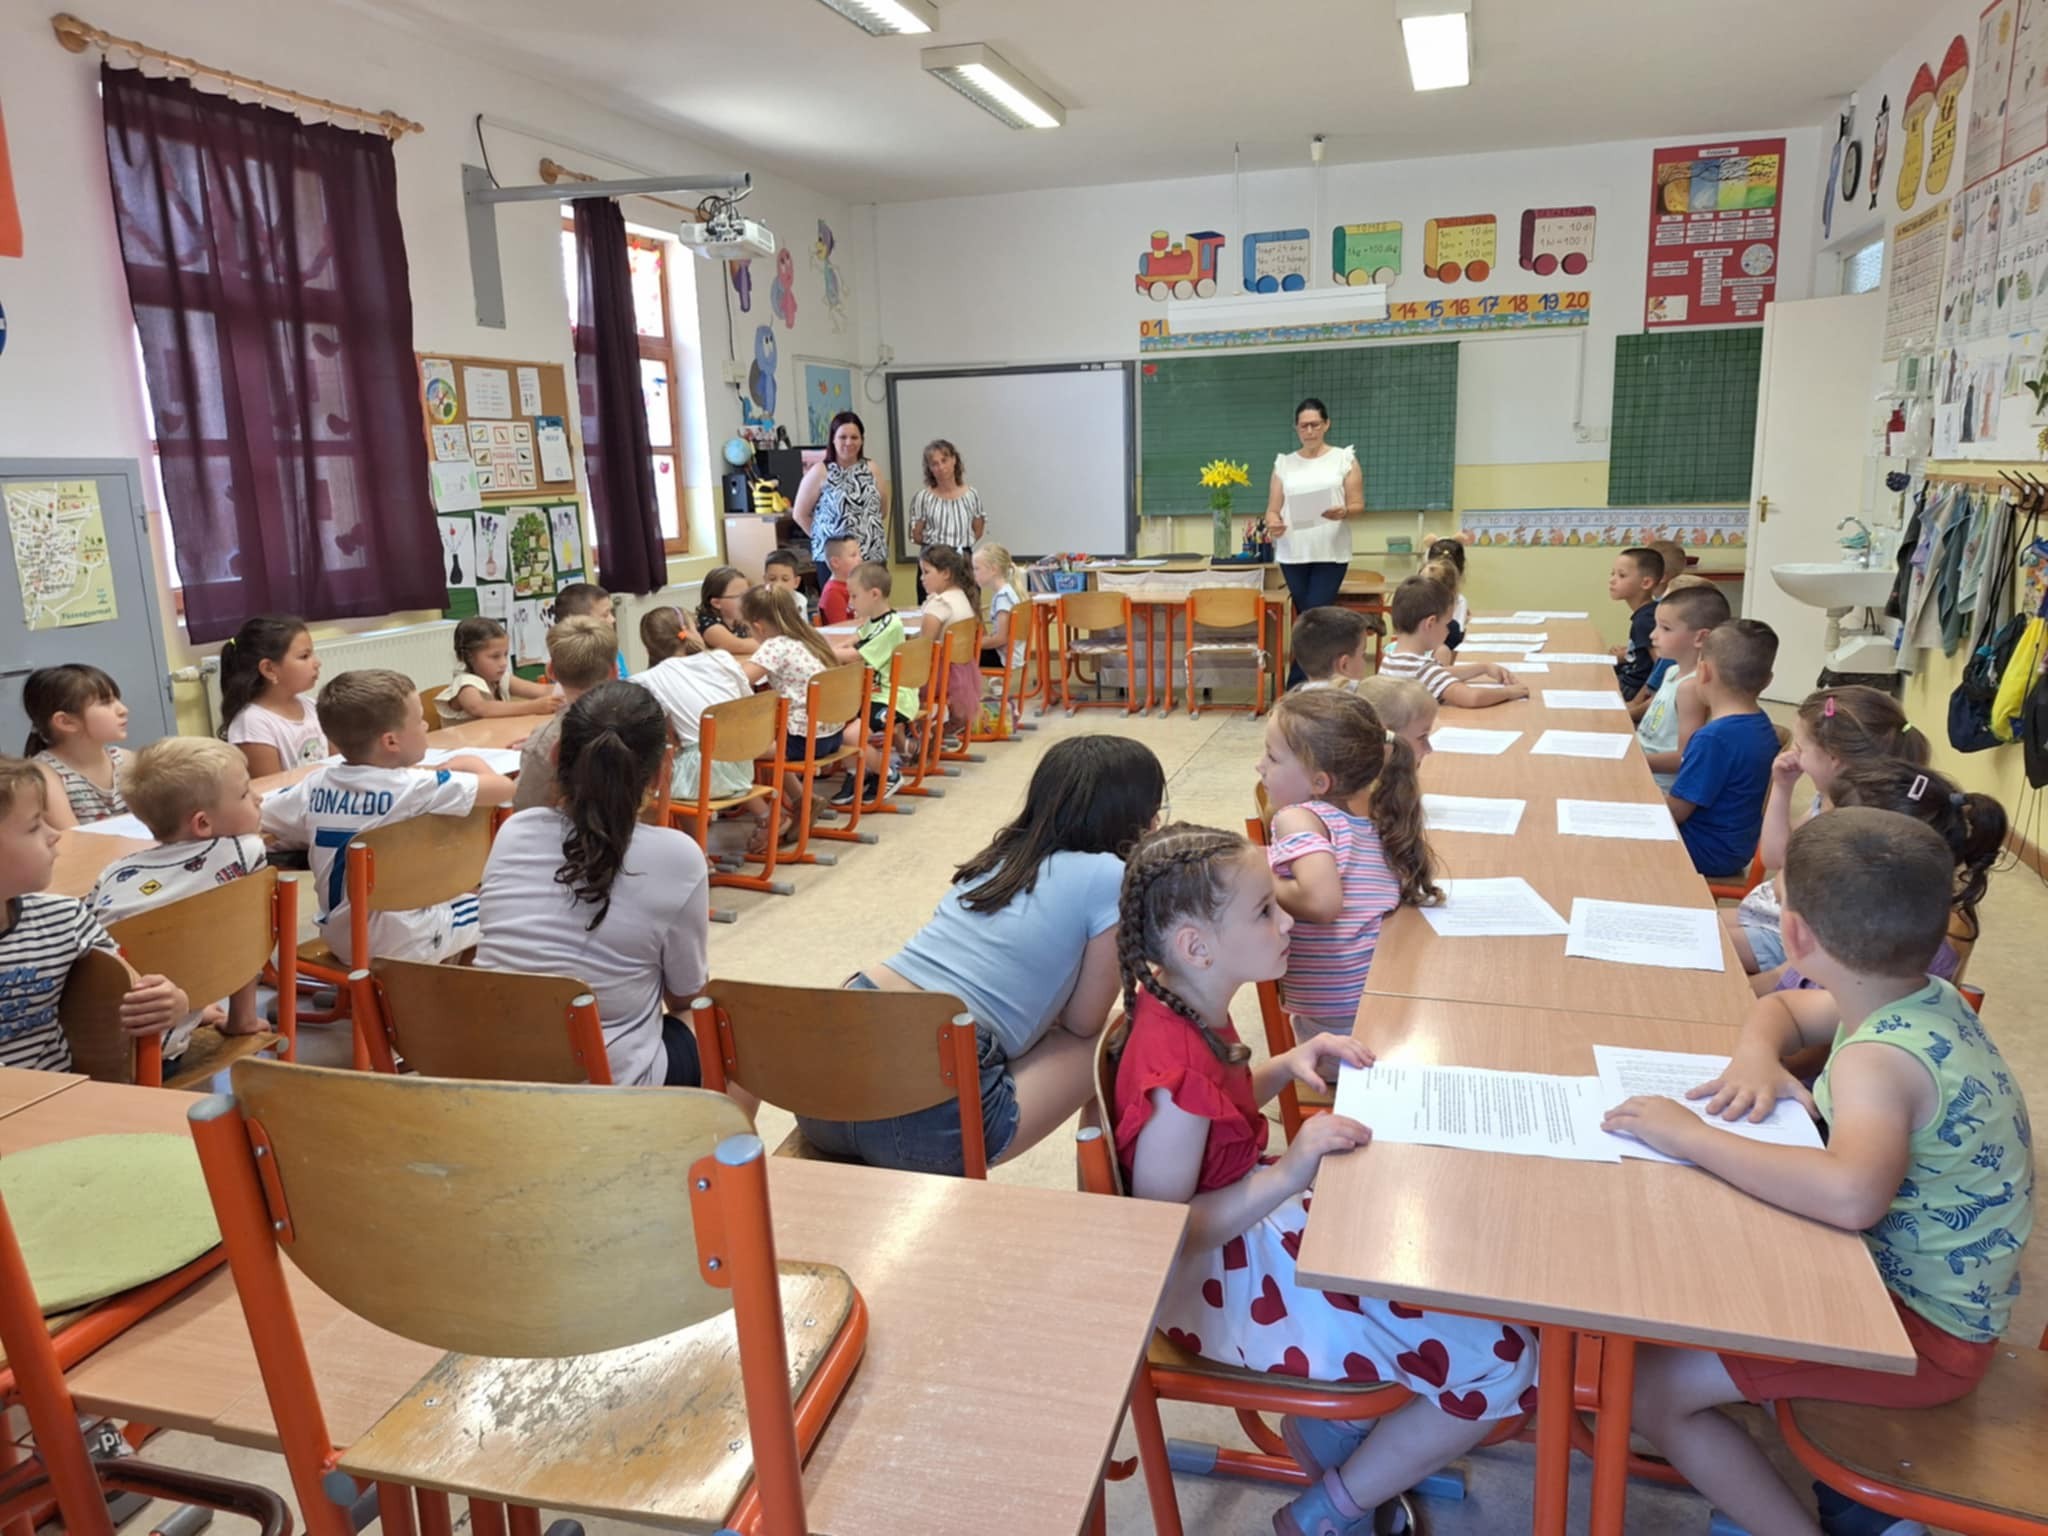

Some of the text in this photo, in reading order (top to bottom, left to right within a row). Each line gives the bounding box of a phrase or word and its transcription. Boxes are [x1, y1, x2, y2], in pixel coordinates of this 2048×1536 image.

[1397, 302, 1419, 319] 14
[1424, 299, 1445, 319] 15
[1449, 298, 1470, 316] 16
[1477, 295, 1500, 314] 17
[1507, 294, 1529, 313] 18
[1538, 293, 1560, 311] 19
[1565, 291, 1590, 309] 20
[1140, 319, 1164, 336] 0 1
[315, 826, 361, 911] 7
